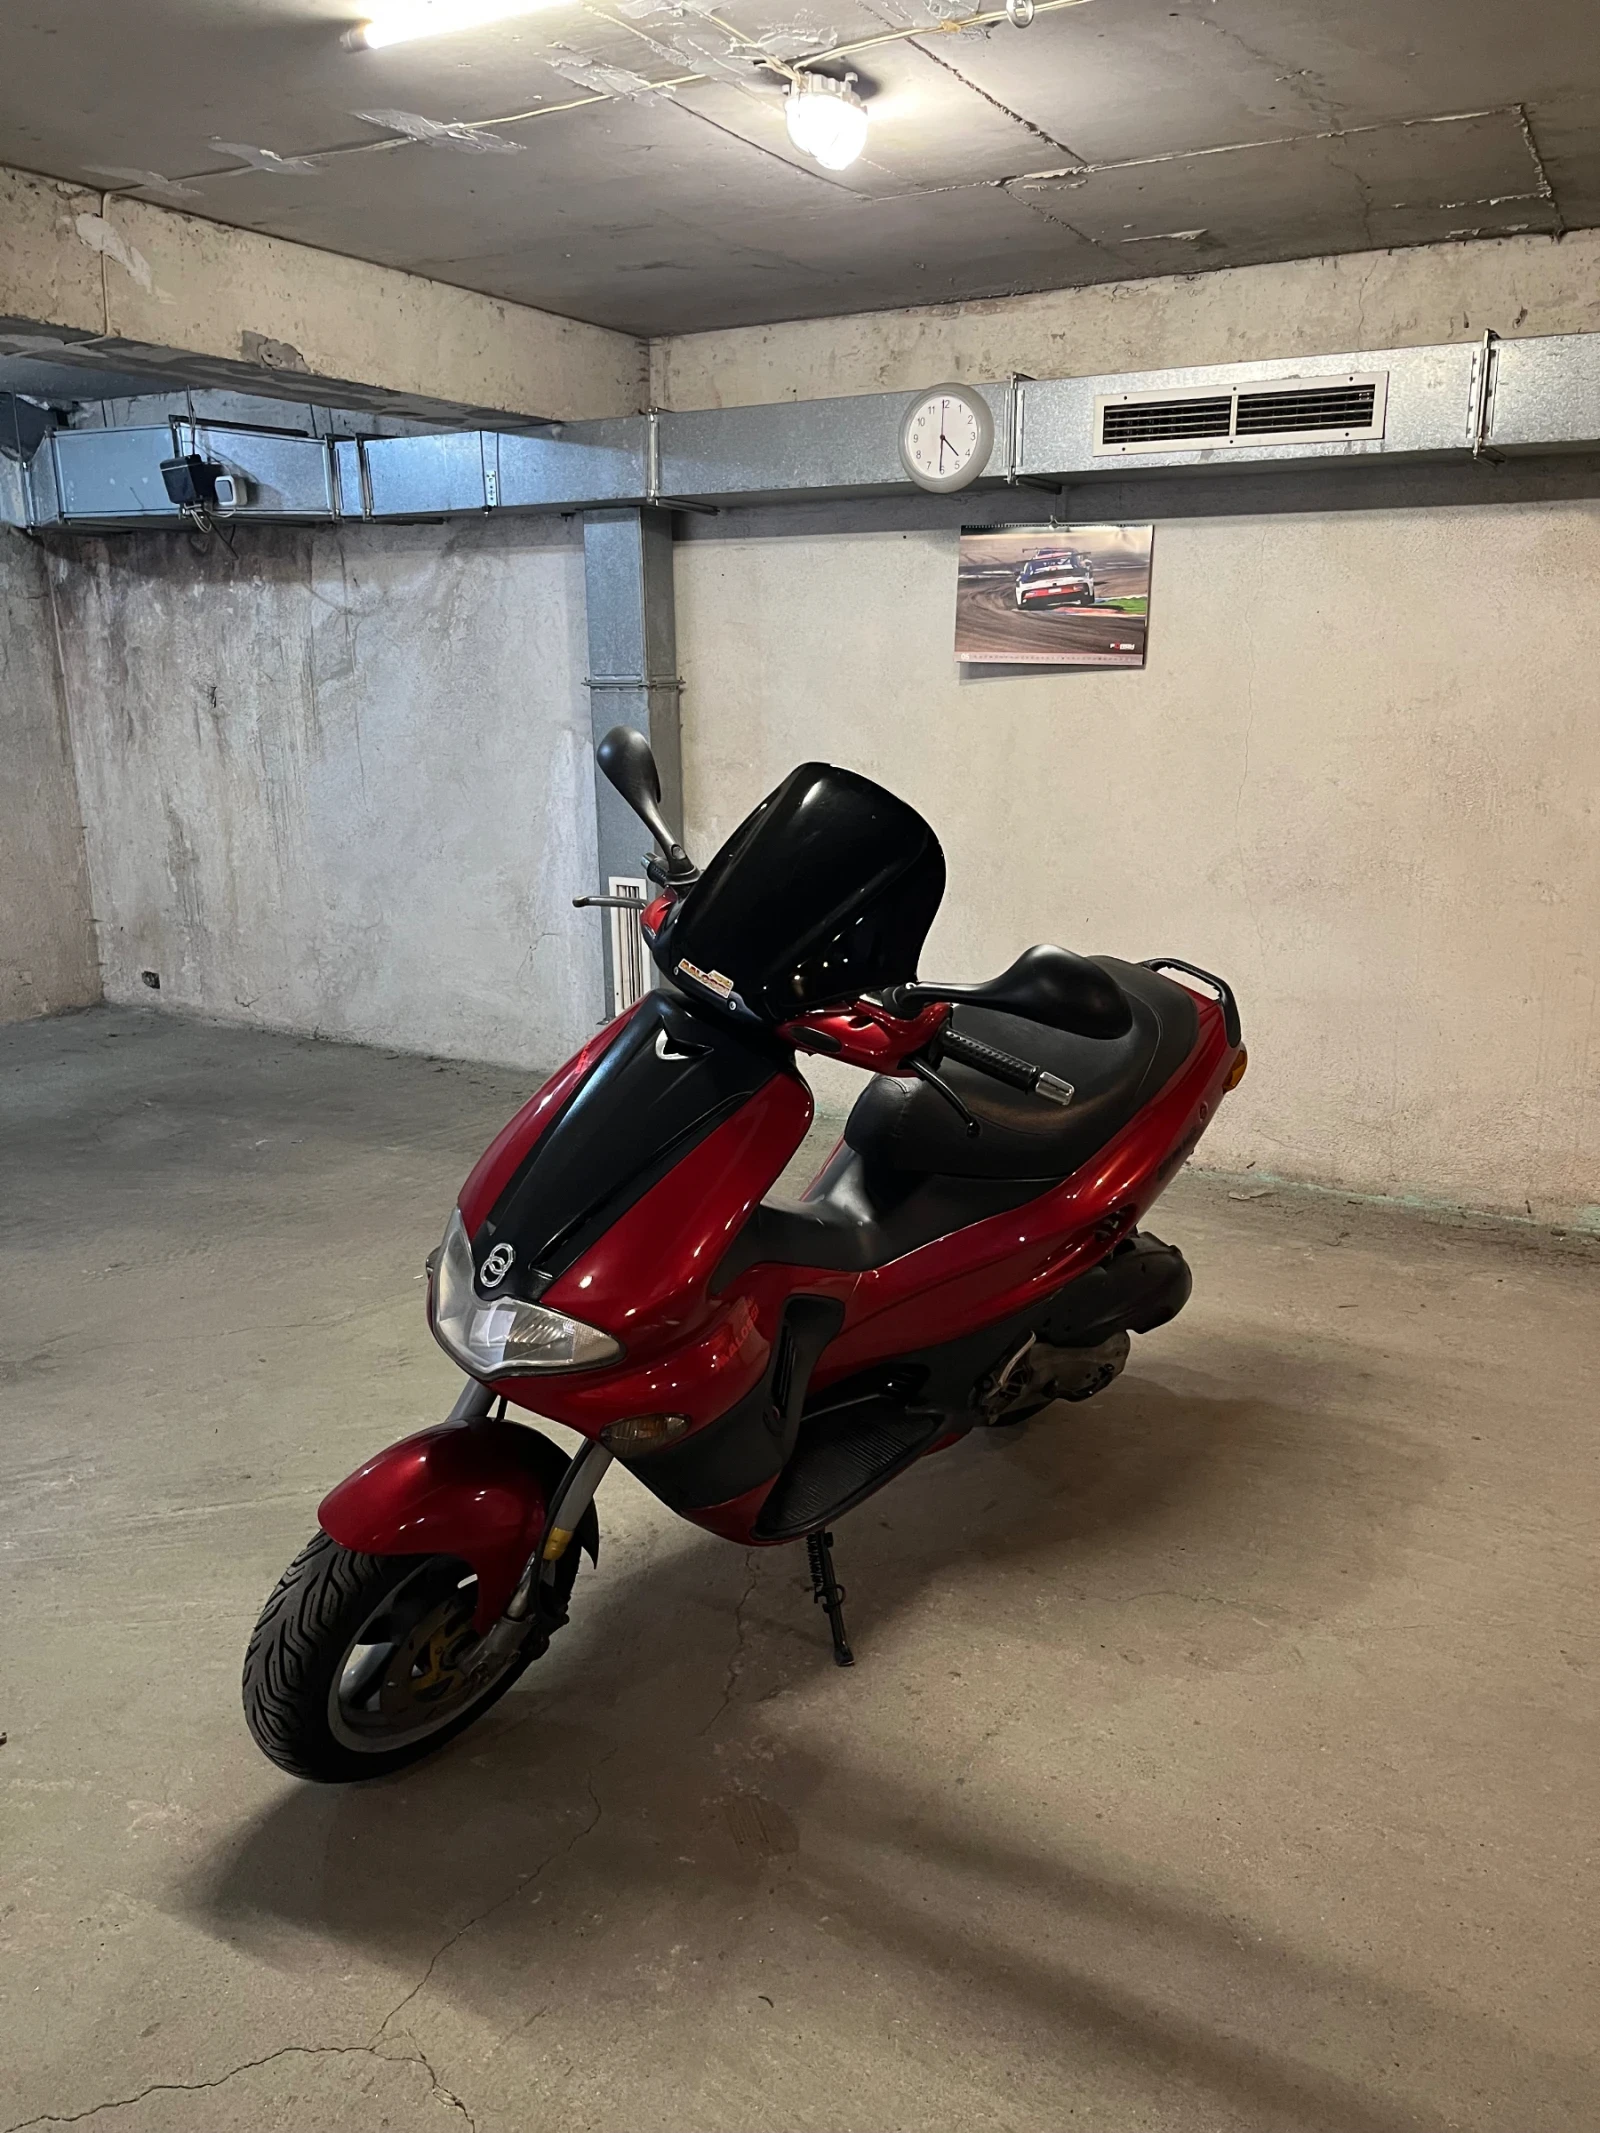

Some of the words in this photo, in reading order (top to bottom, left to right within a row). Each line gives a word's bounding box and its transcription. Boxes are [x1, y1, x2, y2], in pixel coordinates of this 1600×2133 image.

[928, 406, 935, 415] 11
[917, 417, 925, 426] 10
[967, 415, 973, 424] 2
[913, 434, 919, 443] 9
[970, 431, 976, 441] 3
[916, 450, 922, 459] 8
[965, 448, 971, 457] 4
[926, 461, 932, 470] 7
[954, 460, 960, 470] 5
